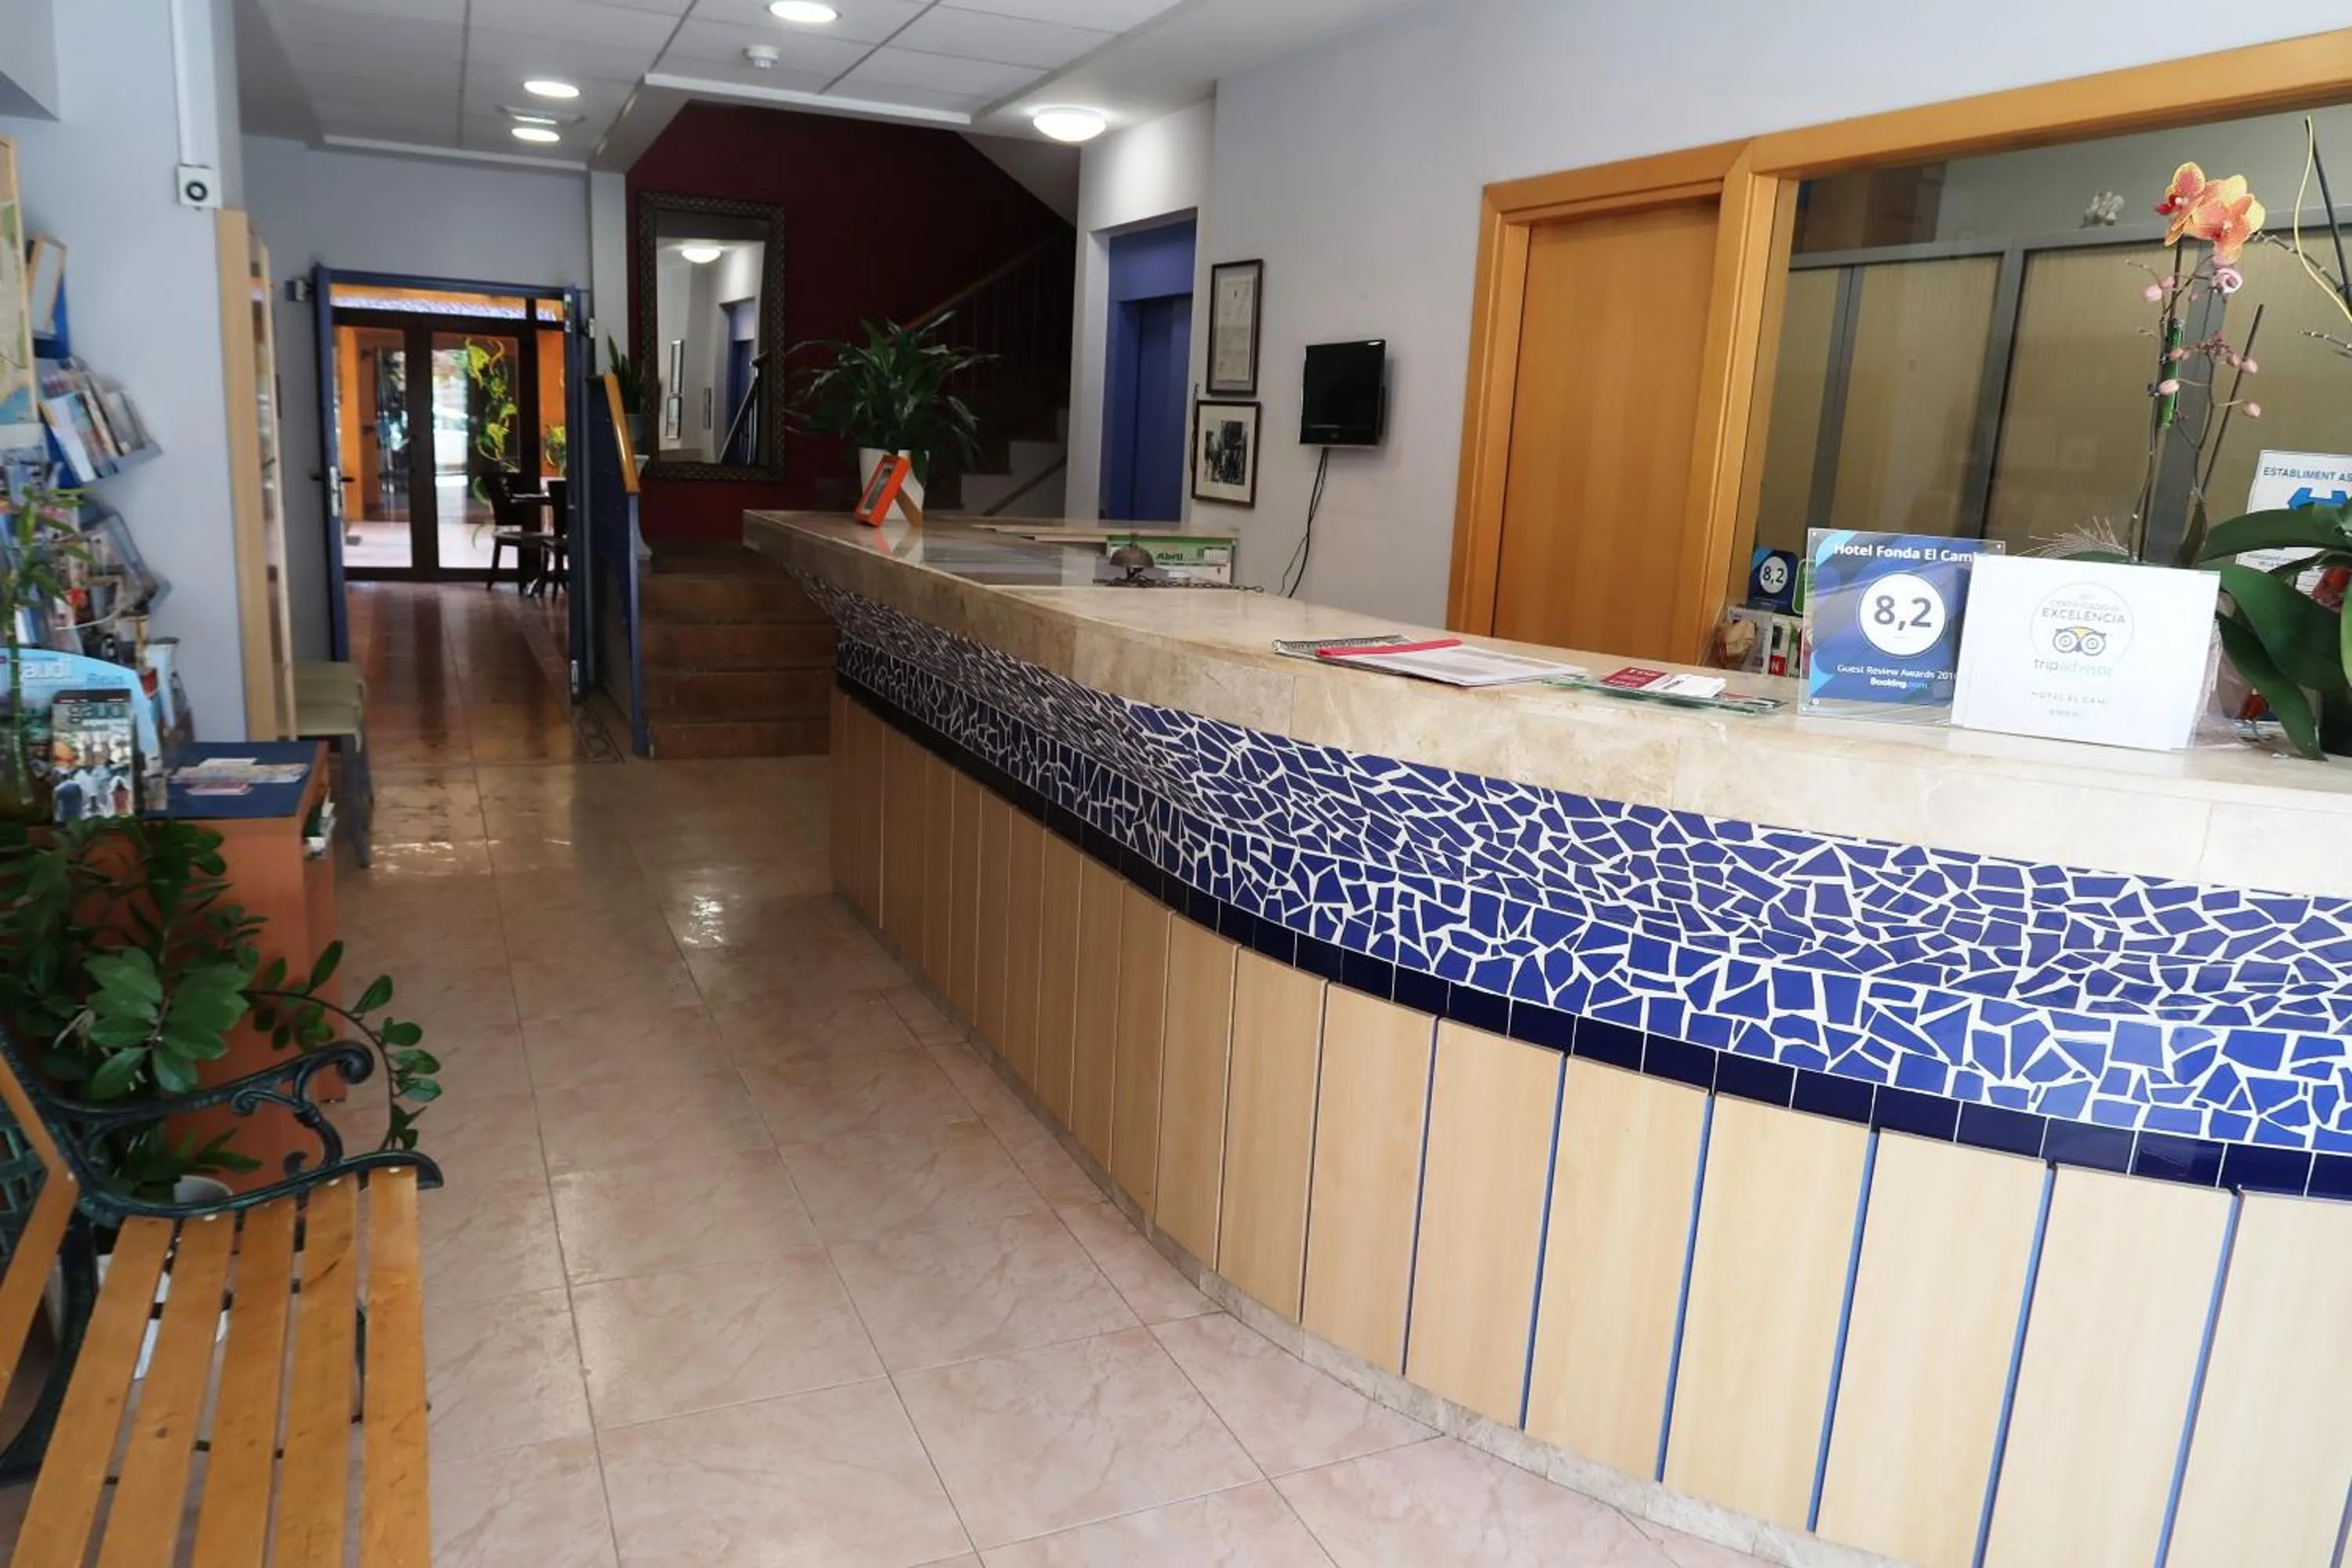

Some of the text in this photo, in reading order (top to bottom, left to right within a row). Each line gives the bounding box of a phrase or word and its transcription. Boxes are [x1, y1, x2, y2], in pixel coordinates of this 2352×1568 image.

[2263, 466, 2336, 481] ESTABLIMENT
[1833, 543, 1976, 563] Hotel Fonda El Cam
[1762, 565, 1785, 585] 8,2
[1874, 594, 1932, 632] 8,2
[2042, 607, 2125, 624] EXCELENCIA
[1837, 664, 1864, 674] Guest
[1867, 666, 1899, 676] Review
[1900, 668, 1935, 679] Awards
[2034, 659, 2114, 677] tripadvisor
